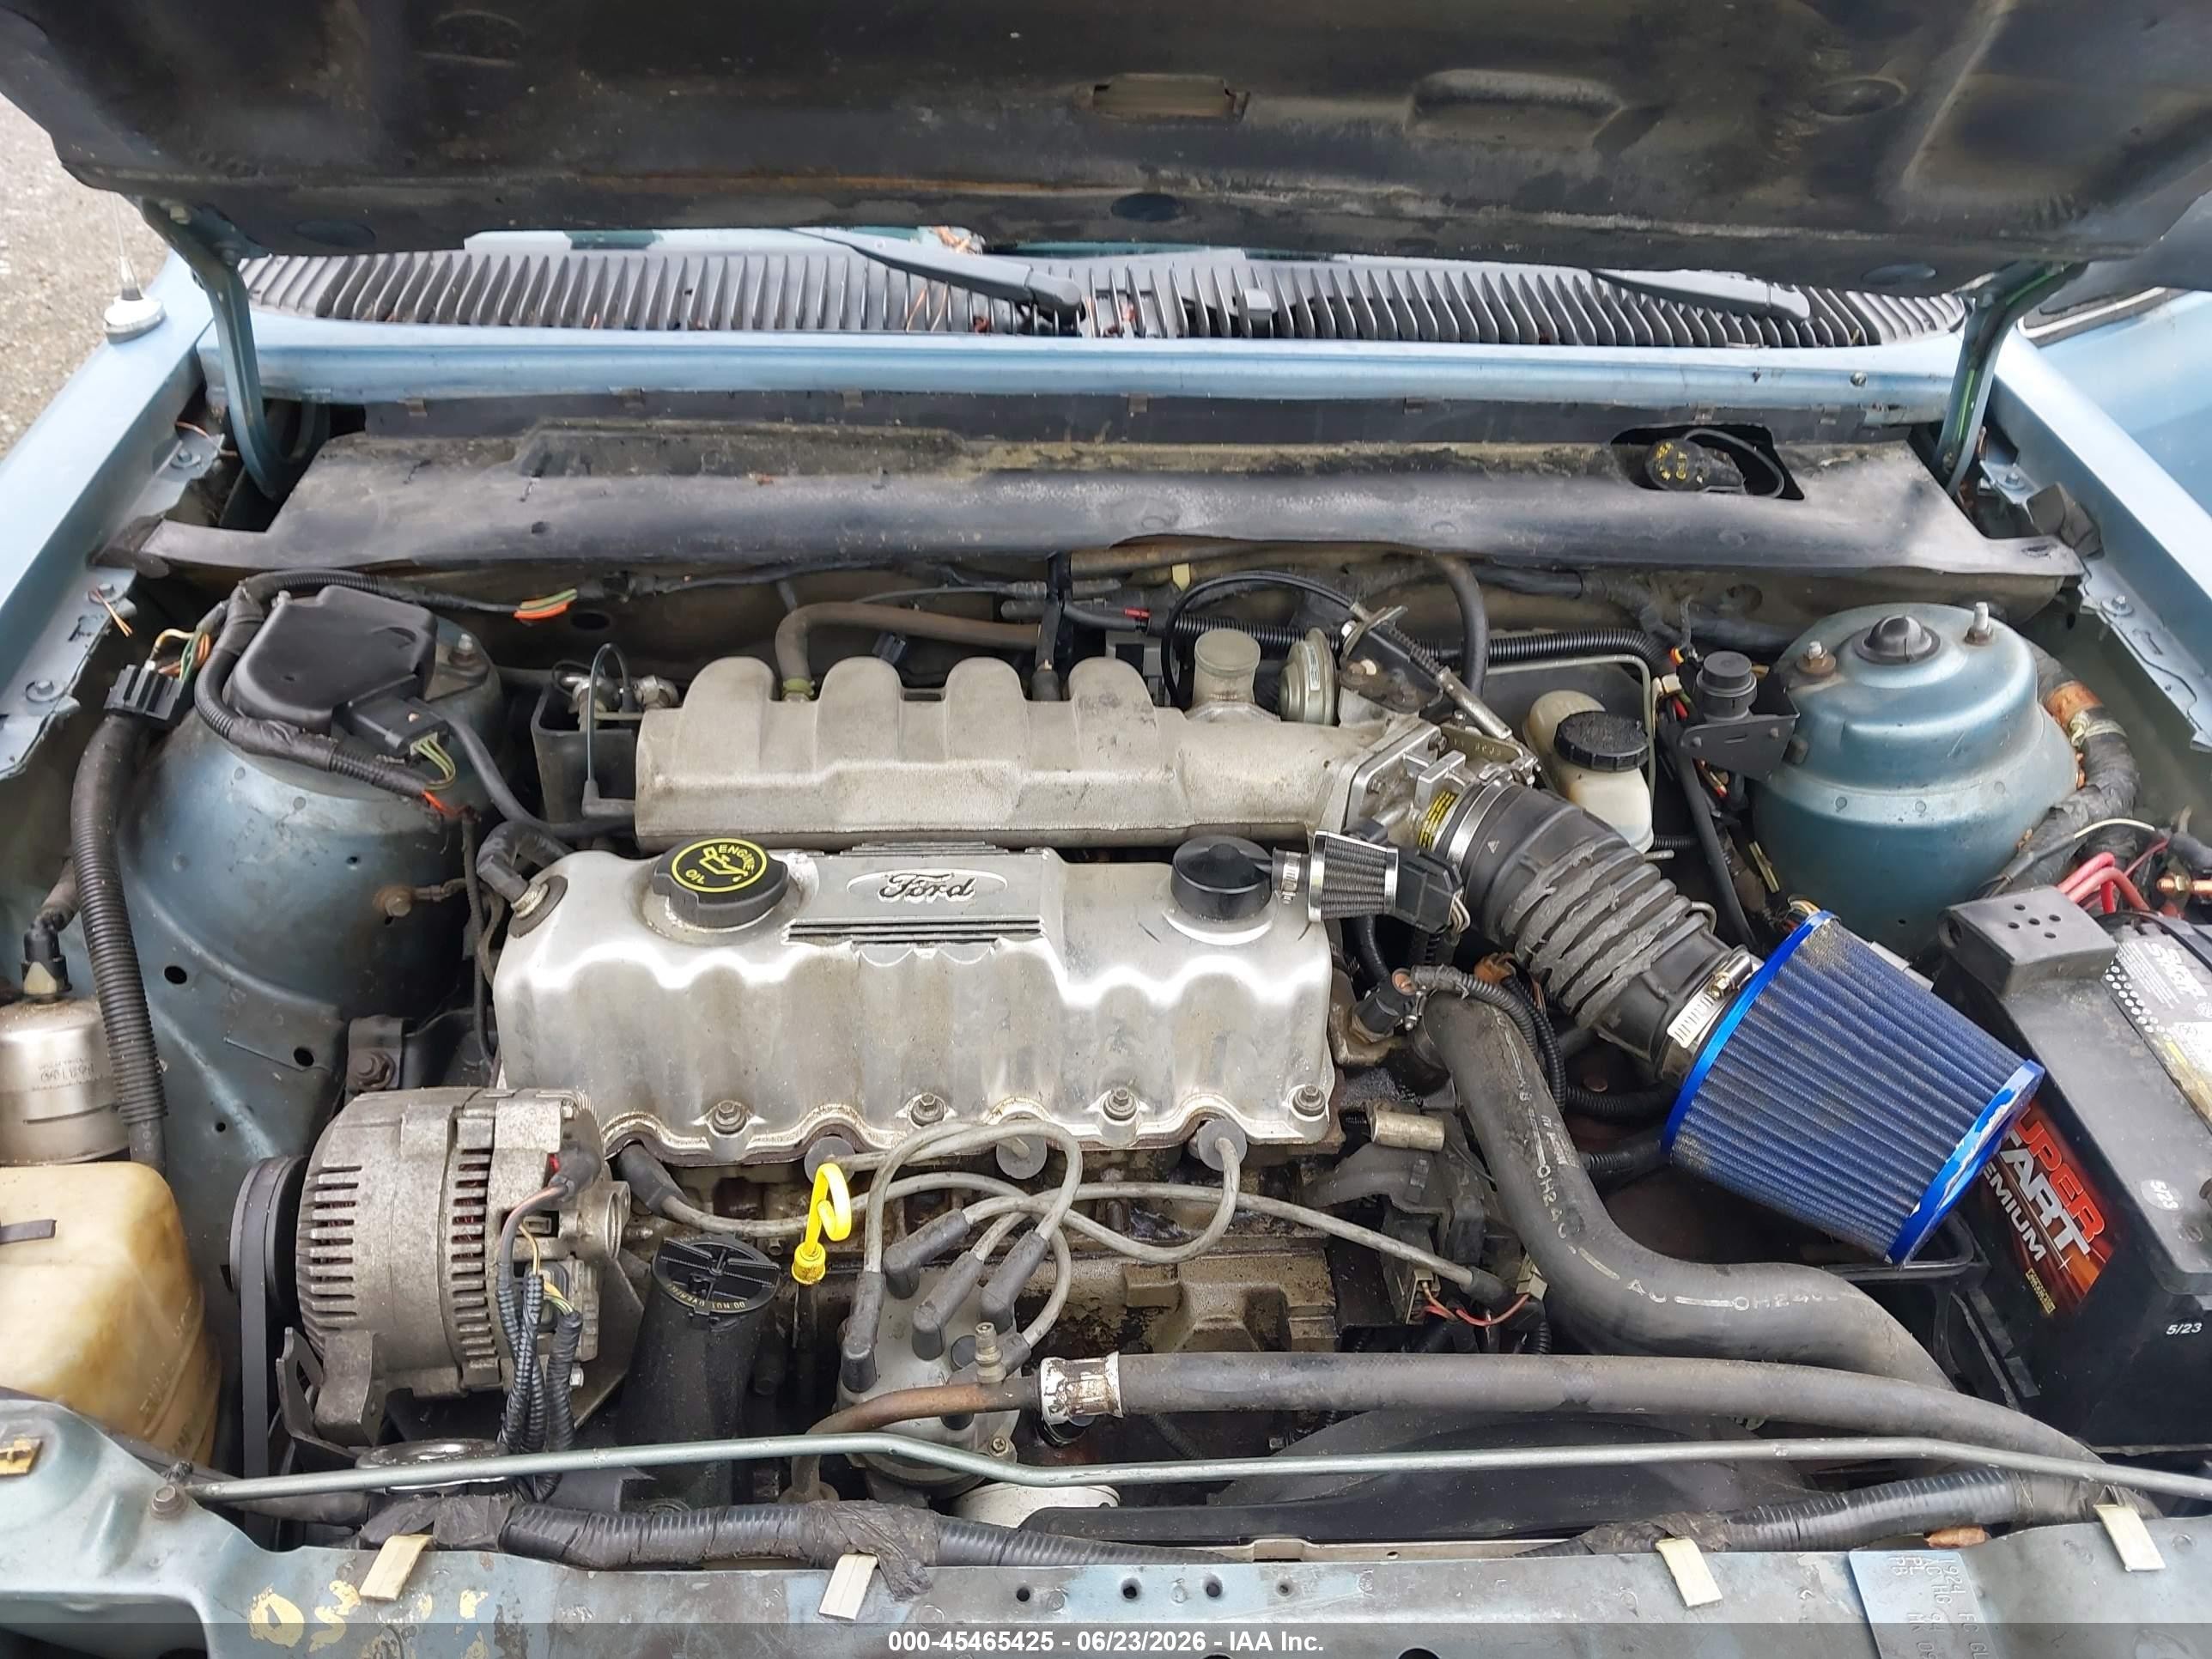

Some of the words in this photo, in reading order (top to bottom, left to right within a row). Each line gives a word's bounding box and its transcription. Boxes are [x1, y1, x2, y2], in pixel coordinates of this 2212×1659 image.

[718, 844, 756, 875] ENGINE
[878, 872, 978, 902] Ford
[1999, 1128, 2091, 1255] ART
[2012, 1107, 2105, 1243] UPER
[1983, 1159, 2047, 1262] EMIUM
[2166, 1322, 2203, 1336] 5/23
[1939, 1559, 1966, 1595] 1924
